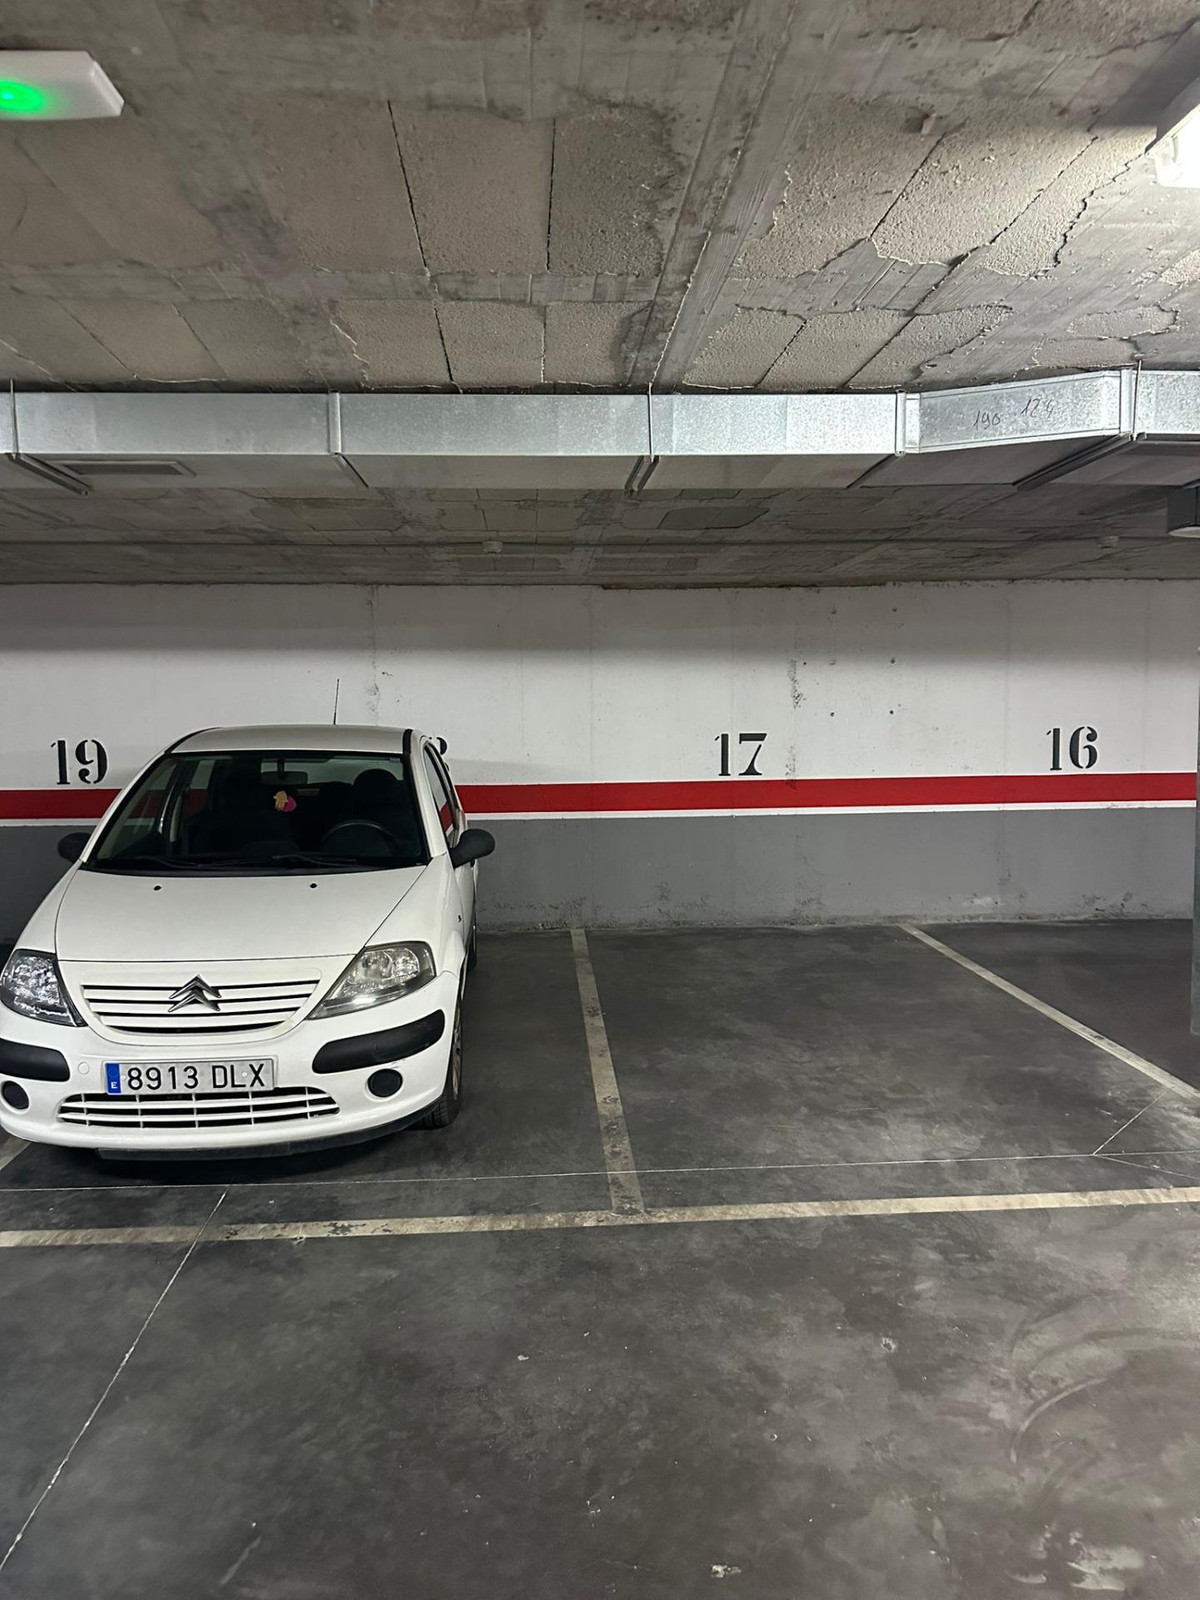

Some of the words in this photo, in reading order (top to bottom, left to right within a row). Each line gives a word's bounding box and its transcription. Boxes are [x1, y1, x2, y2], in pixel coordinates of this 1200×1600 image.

[50, 739, 108, 785] 19
[714, 733, 767, 776] 17
[1046, 726, 1098, 771] 16
[110, 1081, 118, 1089] E
[127, 1065, 199, 1090] 8913
[212, 1063, 265, 1089] DLX
